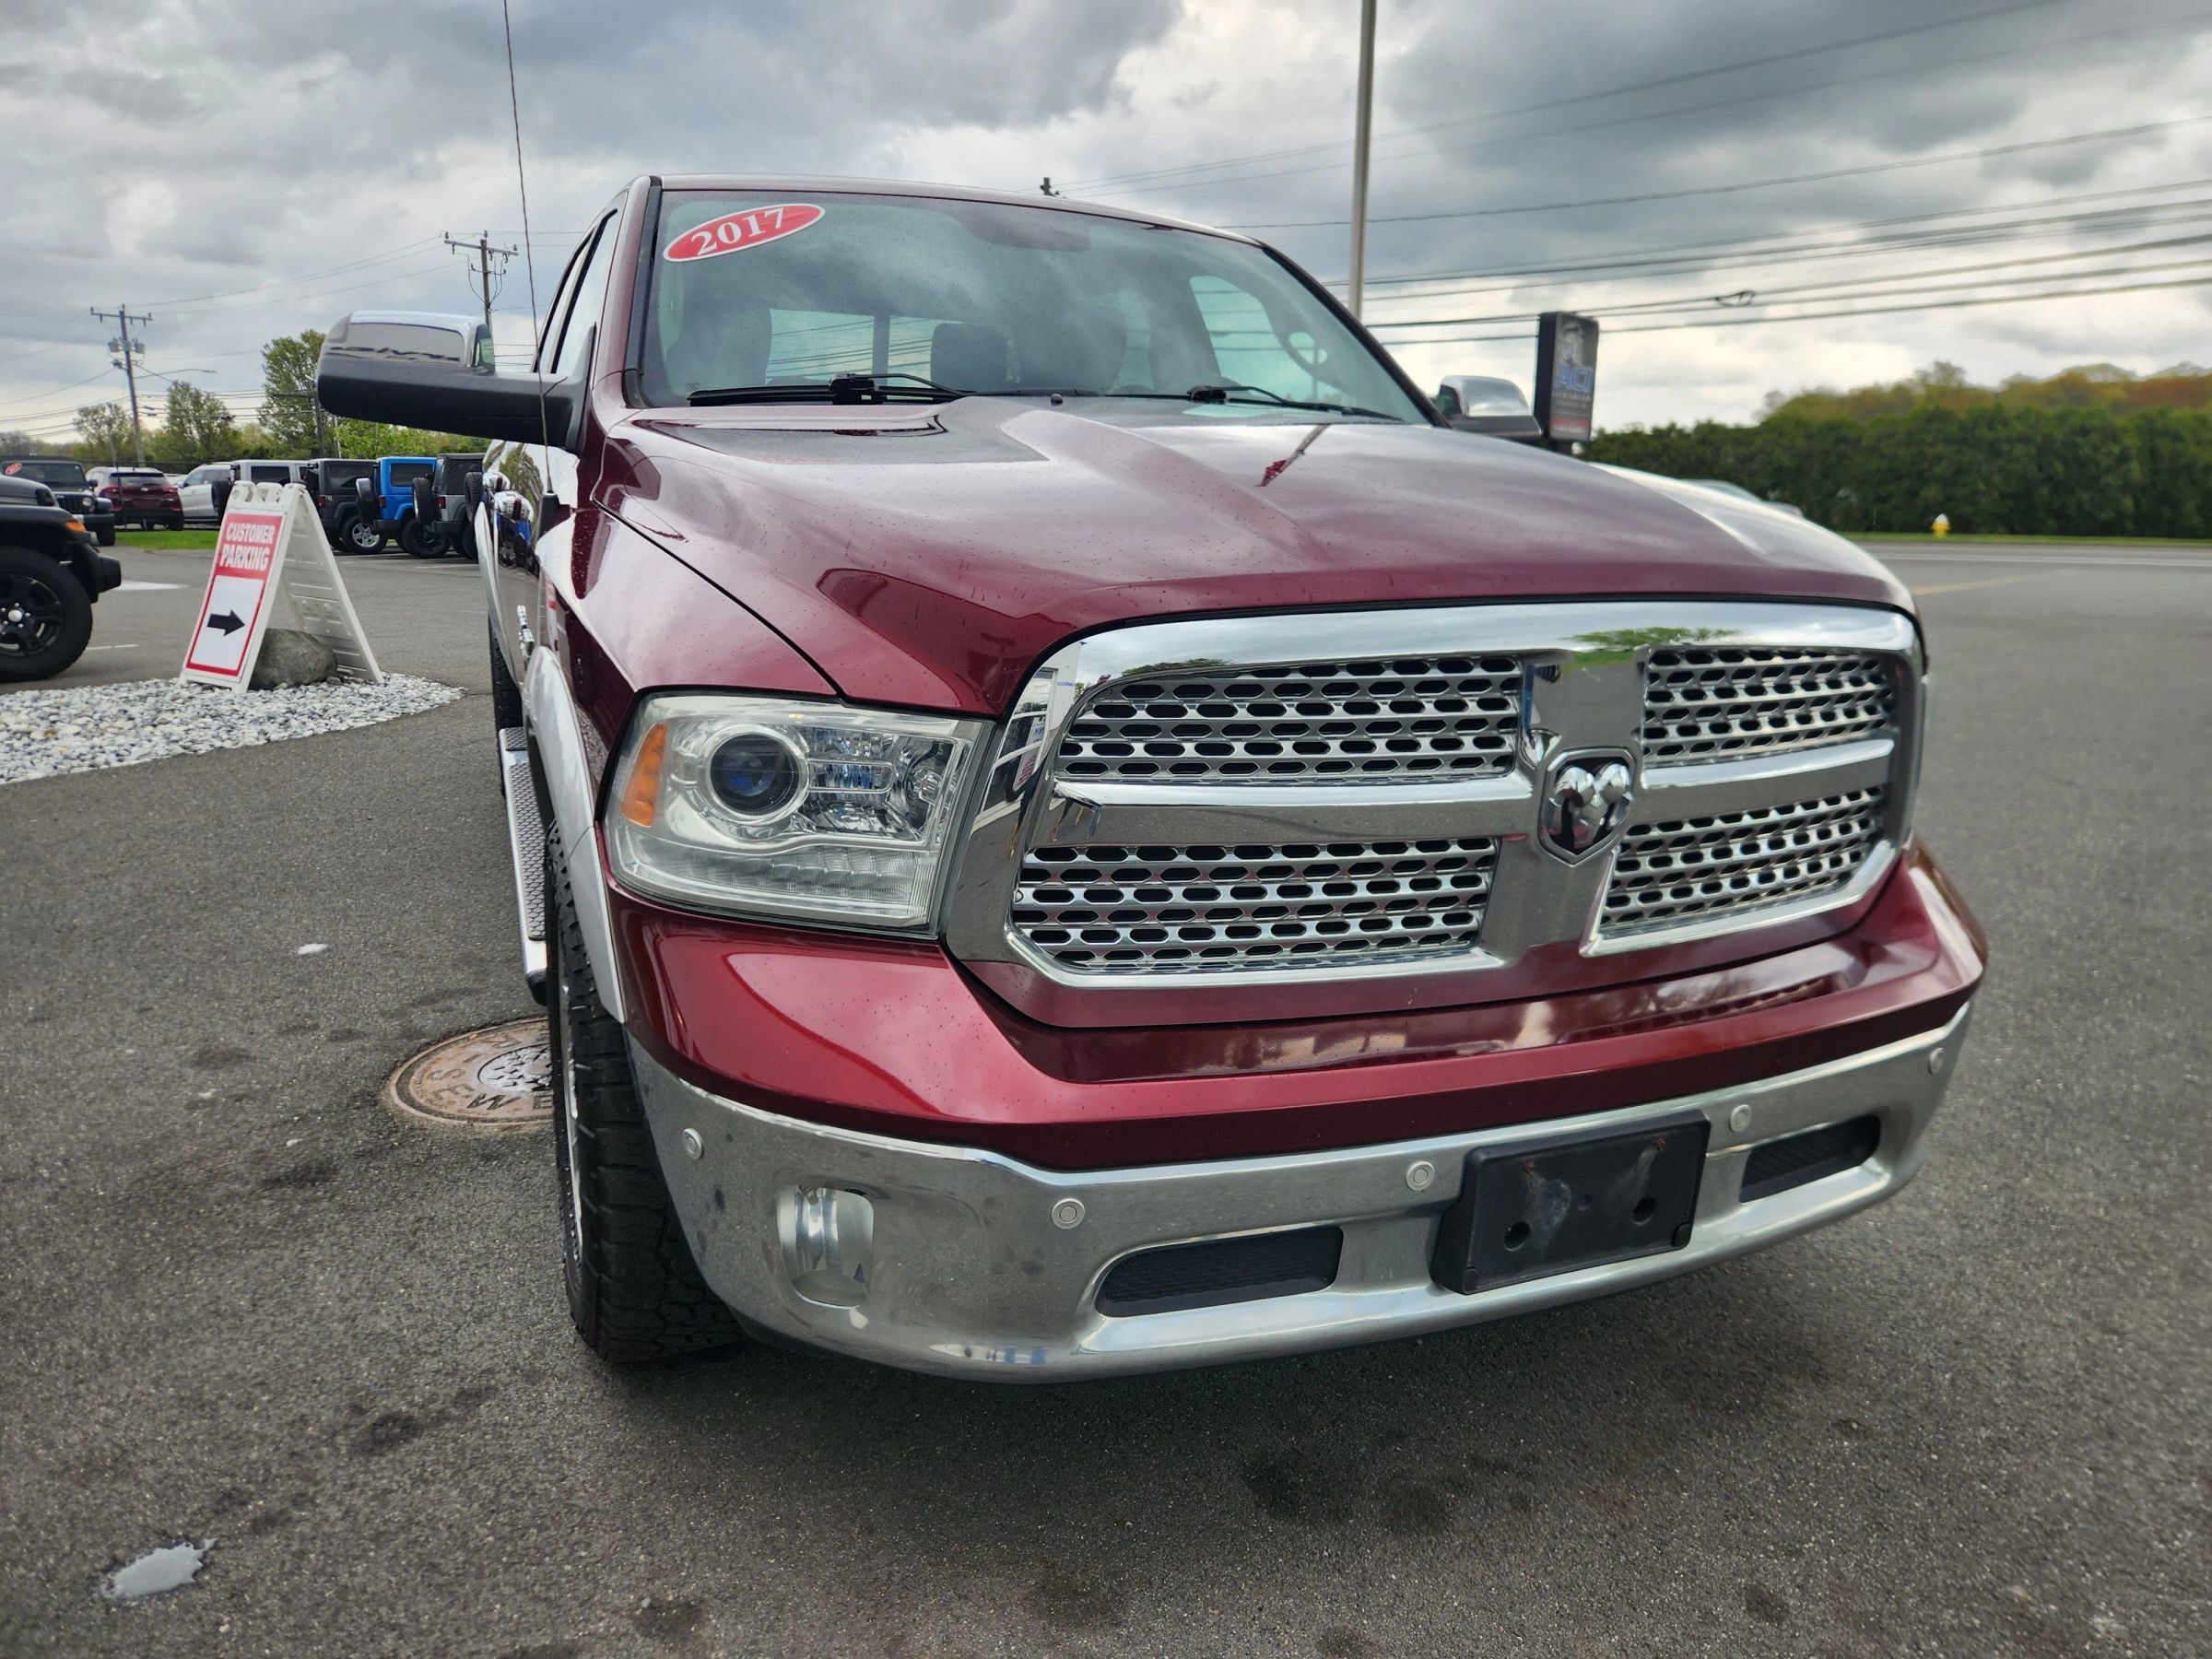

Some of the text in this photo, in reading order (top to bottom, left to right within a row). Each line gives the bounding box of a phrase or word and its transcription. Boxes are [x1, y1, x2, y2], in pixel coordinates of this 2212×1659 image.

[691, 207, 784, 255] 2017
[227, 523, 276, 544] CUSTOMER
[219, 545, 270, 571] PARKING
